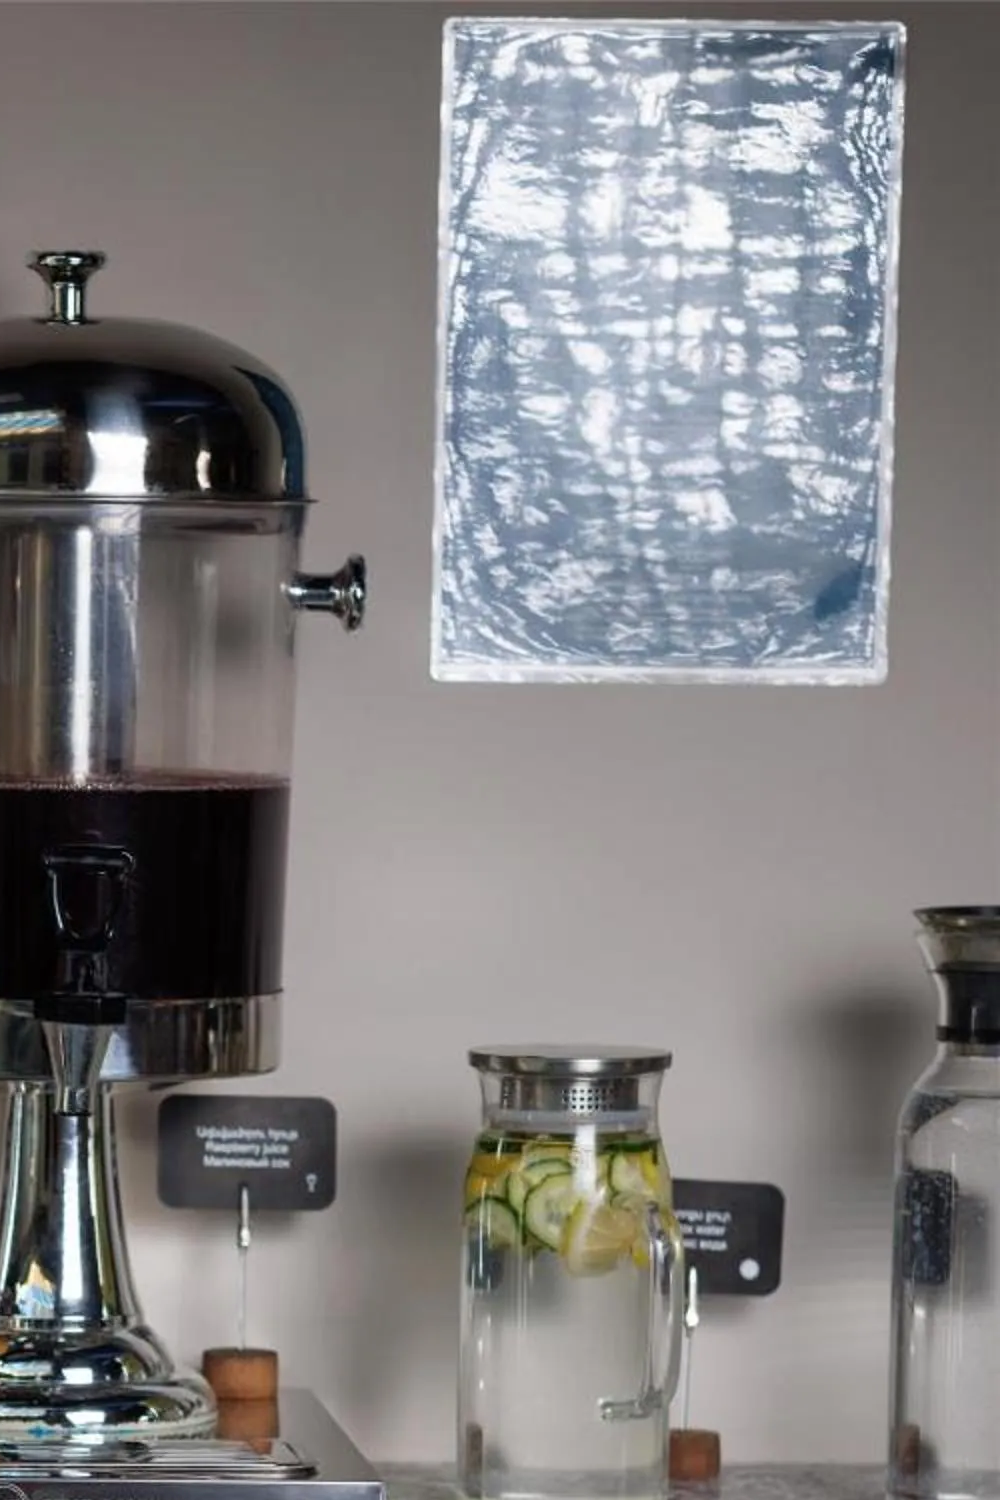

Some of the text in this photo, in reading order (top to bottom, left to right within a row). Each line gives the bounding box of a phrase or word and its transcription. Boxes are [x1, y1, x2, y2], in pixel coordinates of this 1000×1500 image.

[205, 1141, 289, 1156] Raspberry juice
[203, 1155, 291, 1168] Малиновый сок
[695, 1225, 727, 1236] water
